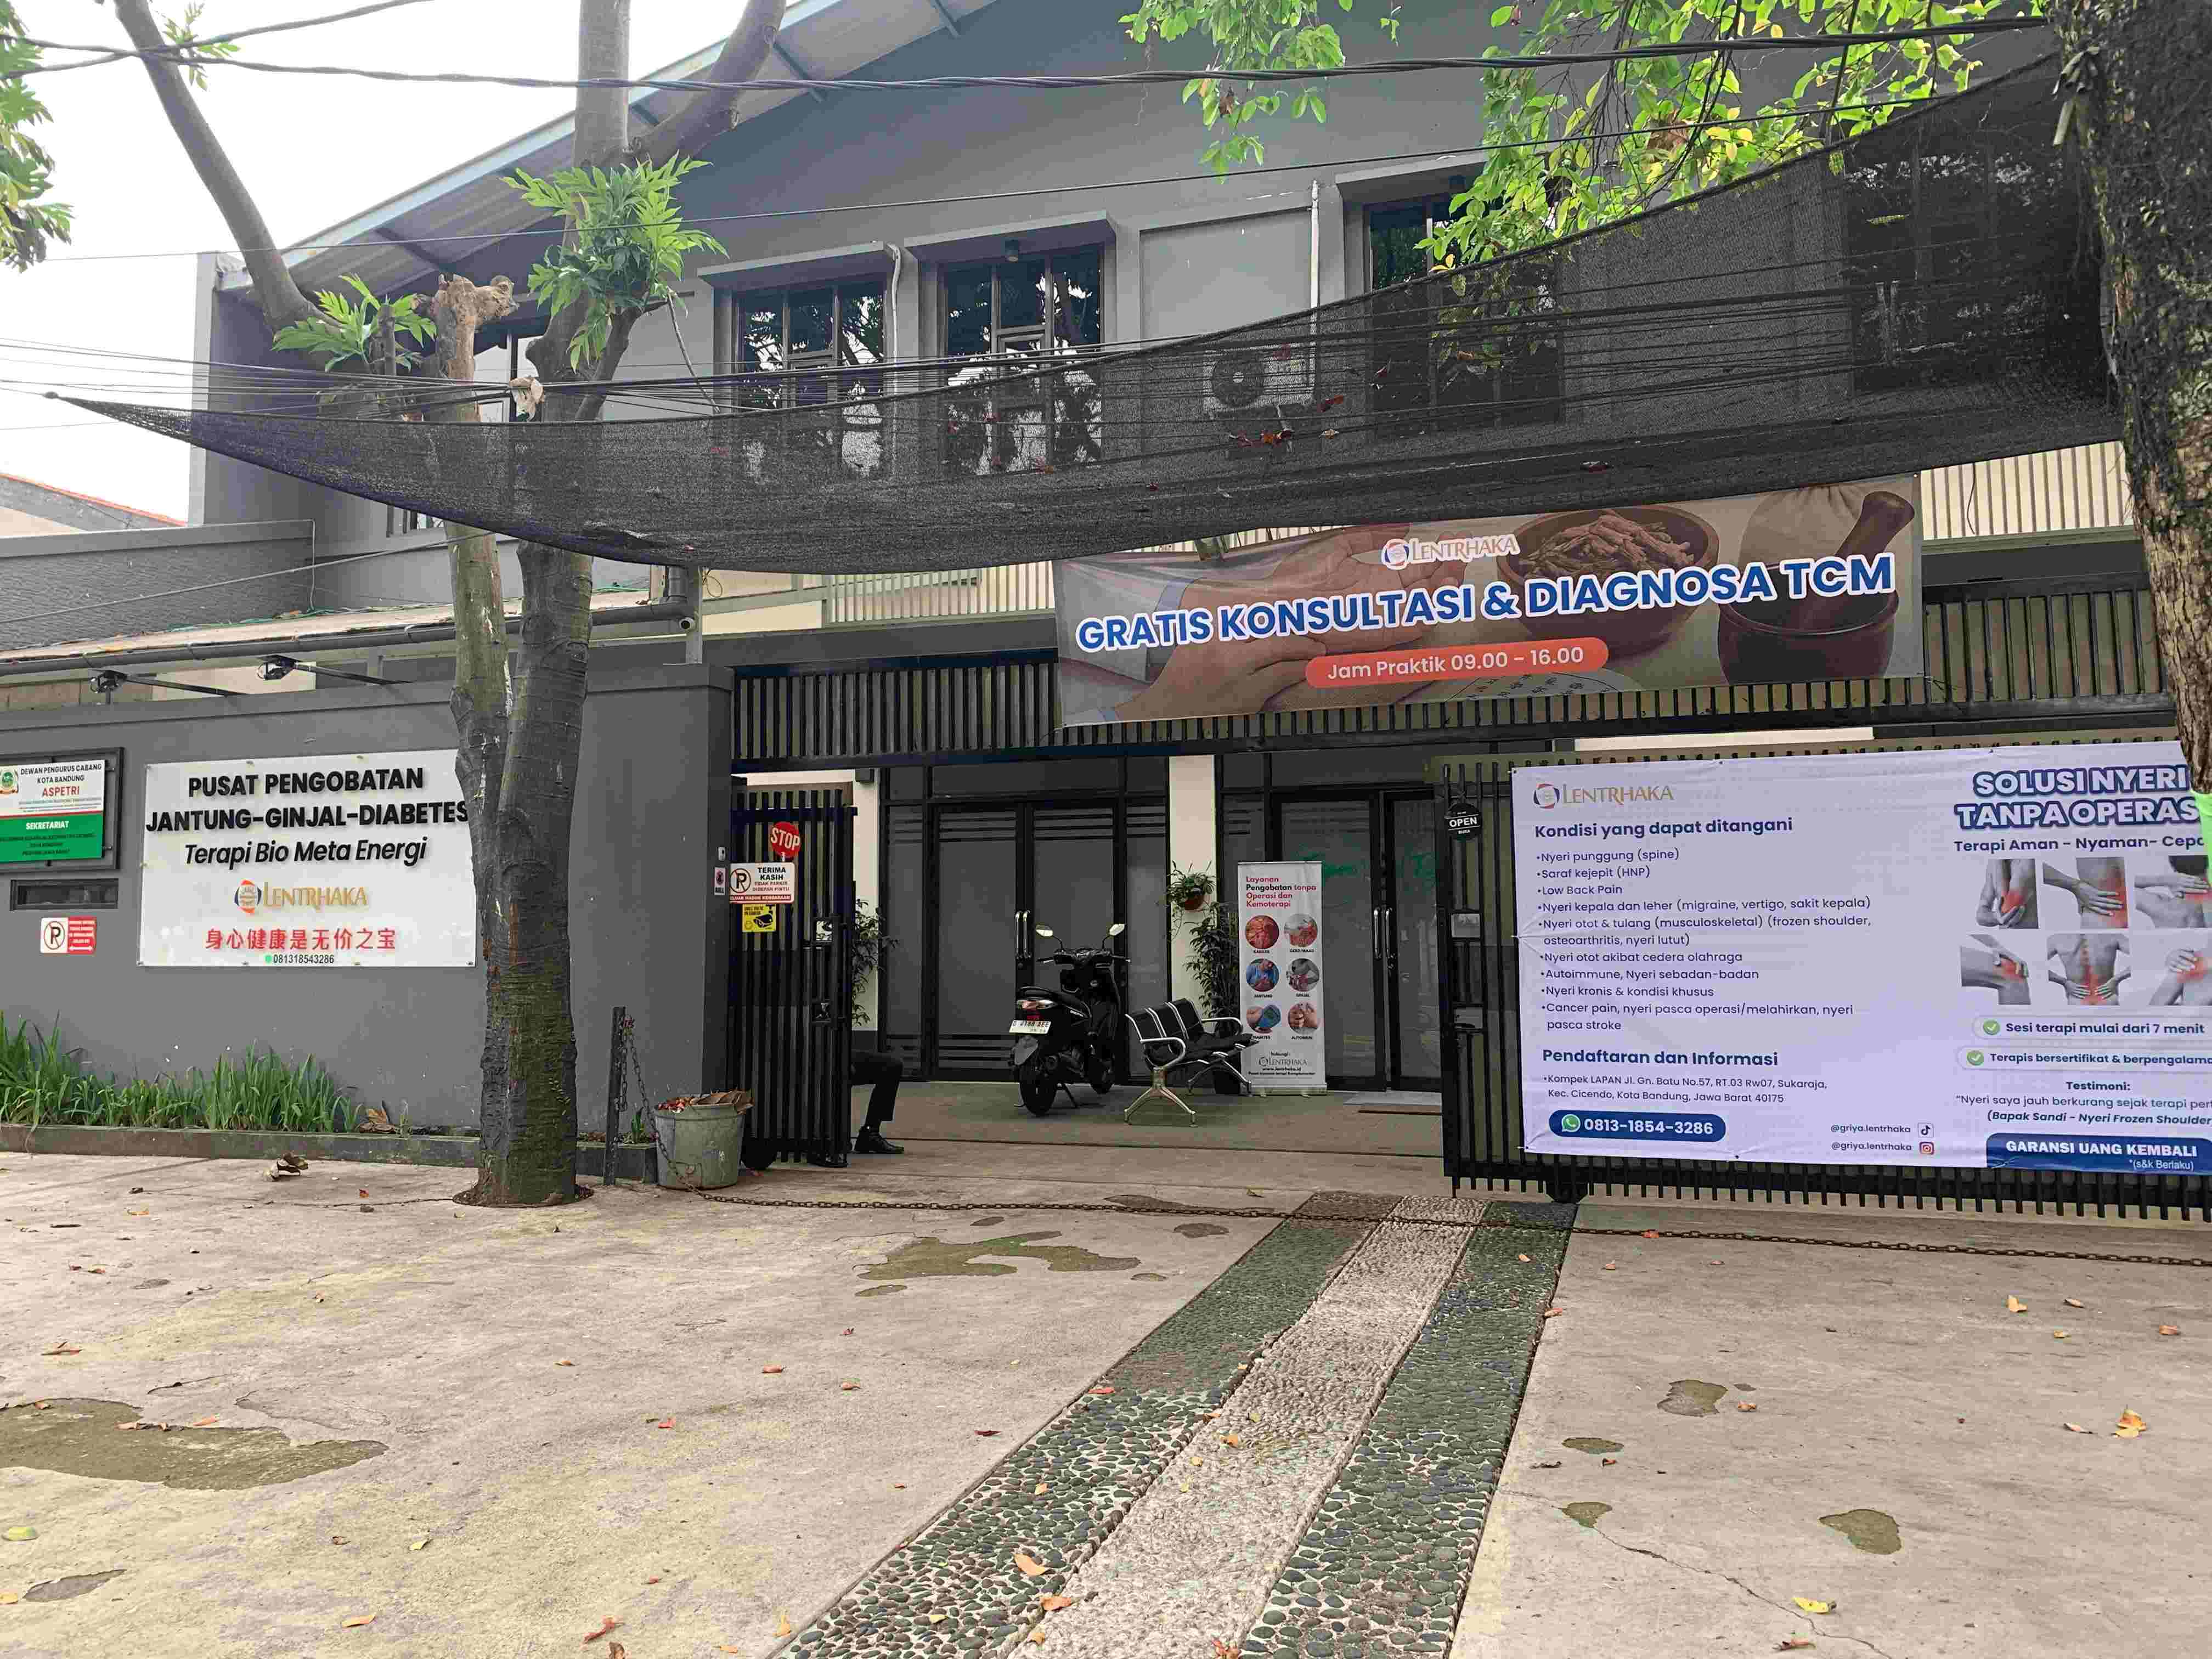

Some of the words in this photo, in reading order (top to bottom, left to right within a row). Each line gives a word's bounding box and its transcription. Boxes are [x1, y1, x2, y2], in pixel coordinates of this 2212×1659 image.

[1410, 535, 1519, 563] LENTRHAKA
[1079, 611, 1211, 650] GRATIS
[1220, 587, 1472, 637] KONSULTASI
[1484, 584, 1516, 616] &
[1528, 565, 1771, 614] DIAGNOSA
[1784, 555, 1891, 597] TCM
[1328, 664, 1371, 679] Jam
[1376, 656, 1446, 676] Praktik
[1451, 652, 1508, 670] 09.00
[1530, 646, 1583, 665] 16.00
[44, 765, 75, 774] PENGURUS
[75, 763, 102, 771] CABANG
[55, 774, 85, 782] BANDUNG
[188, 774, 258, 798] PUSAT
[265, 768, 424, 794] PENGOBATAN
[1974, 770, 2086, 797] SOLUSI
[2088, 765, 2190, 792] NYERI
[42, 786, 80, 797] ASPETRI
[1562, 784, 1674, 805] LENTRHAKA
[146, 800, 469, 831] JANTUNG-GINJAL-DIABETES
[1449, 816, 1477, 827] OPEN
[1954, 801, 2069, 830] TANPA
[26, 821, 69, 830] SEKRETARIAT
[1535, 822, 1597, 838] Kondisi
[1600, 825, 1645, 840] yang
[1649, 821, 1702, 838] dapat
[1705, 817, 1792, 836] ditangani
[771, 827, 800, 851] STOP
[1954, 838, 2005, 854] Terapi
[2009, 839, 2059, 850] Aman
[185, 841, 252, 871] Terapi
[255, 840, 289, 863] Bio
[294, 840, 352, 862] Meta
[355, 836, 428, 867] Energi
[1541, 851, 1570, 864] Nyeri
[1573, 853, 1633, 864] punggung
[1637, 847, 1679, 862] (spine)
[1541, 868, 1572, 878] Saraf
[1575, 867, 1613, 881] kejepit
[1617, 865, 1650, 878] (HNP)
[263, 882, 367, 911] LENTRHAKA
[1542, 886, 1564, 895] Low
[1567, 885, 1595, 895] Back
[1597, 884, 1623, 894] Pain
[1246, 900, 1291, 909] Kemoterapi
[1542, 902, 1572, 915] Nyeri
[1575, 901, 1615, 914] kepala
[1617, 901, 1640, 911] dan
[1643, 901, 1673, 910] leher
[1677, 898, 1739, 913] (migraine,
[1741, 899, 1787, 912] vertigo,
[1790, 898, 1819, 909] sakit
[1822, 895, 1870, 911] kepala)
[1543, 918, 1572, 931] Nyeri
[1575, 919, 1598, 928] otot
[1601, 919, 1610, 928] &
[1613, 918, 1651, 930] tulang
[1655, 915, 1763, 930] (musculoskeletal)
[1768, 915, 1810, 928] (frozen
[1813, 916, 1871, 927] shoulder,
[205, 928, 396, 950] 身心健康是无价之宝
[1544, 935, 1623, 946] osteoarthritis,
[1626, 935, 1655, 947] nyeri
[1658, 932, 1690, 946] lutut)
[273, 954, 334, 963] 081318543286
[1544, 952, 1573, 964] Nyeri
[1576, 953, 1600, 962] otot
[1602, 952, 1640, 962] akibat
[1642, 952, 1684, 962] cedera
[1688, 952, 1742, 964] olahraga
[1545, 969, 1623, 980] Autoimmune,
[1626, 969, 1656, 981] Nyeri
[1659, 969, 1759, 979] sebadan-badan
[1545, 985, 1575, 998] Nyeri
[1577, 986, 1612, 996] kronis
[1615, 987, 1624, 996] &
[1627, 986, 1668, 997] kondisi
[1672, 987, 1714, 996] khusus
[1545, 1003, 1589, 1012] Cancer
[1592, 1003, 1620, 1015] pain,
[1623, 1003, 1652, 1016] nyeri
[1655, 1006, 1692, 1016] pasca
[1695, 1002, 1819, 1017] operasi/melahirkan,
[1822, 1005, 1853, 1017] nyeri
[1547, 1022, 1583, 1031] pasca
[1585, 1020, 1621, 1030] stroke
[2006, 1022, 2033, 1032] Sesi
[2035, 1022, 2076, 1036] terapi
[2080, 1023, 2119, 1033] mulai
[2122, 1023, 2150, 1034] dari
[2153, 1024, 2160, 1034] 7
[2163, 1023, 2205, 1034] menit
[1543, 1049, 1650, 1064] Pendaftaran
[1654, 1051, 1688, 1064] dan
[1692, 1051, 1778, 1066] Informasi
[1990, 1053, 2033, 1064] Terapis
[2036, 1053, 2109, 1063] bersertifikat
[2112, 1055, 2120, 1063] &
[1548, 1075, 1589, 1086] Kompek
[1590, 1076, 1622, 1084] LAPAN
[1637, 1076, 1654, 1085] Gn.
[1656, 1077, 1680, 1086] Batu
[1682, 1077, 1713, 1087] No.57,
[1716, 1078, 1743, 1087] RT.03
[1745, 1079, 1775, 1089] Rw07,
[1778, 1079, 1827, 1091] Sukaraja,
[2066, 1081, 2131, 1091] Testimoni:
[1548, 1089, 1569, 1098] Kec.
[1571, 1090, 1615, 1100] Cicendo,
[1617, 1091, 1640, 1099] Kota
[1642, 1091, 1691, 1103] Bandung,
[1694, 1093, 1721, 1101] Jawa
[1724, 1093, 1752, 1102] Barat
[1755, 1094, 1784, 1103] 40175
[1992, 1097, 2021, 1107] saya
[2023, 1096, 2049, 1108] jauh
[2052, 1097, 2113, 1109] berkurang
[2117, 1098, 2148, 1110] sejak
[2151, 1099, 2187, 1111] terapi
[1987, 1110, 2030, 1122] (Bapak
[2033, 1112, 2067, 1121] Sandi
[2078, 1113, 2111, 1125] Nyeri
[2113, 1114, 2153, 1124] Frozen
[1584, 1119, 1713, 1135] 0813-1854-3286
[1830, 1123, 1911, 1134] @griya.lentrhaka
[1831, 1141, 1912, 1152] @griya.lentrhaka
[2005, 1141, 2076, 1154] GARANSI
[2078, 1142, 2123, 1155] UANG
[2126, 1144, 2197, 1157] KEMBALI
[2155, 1160, 2195, 1172] Berlaku)
